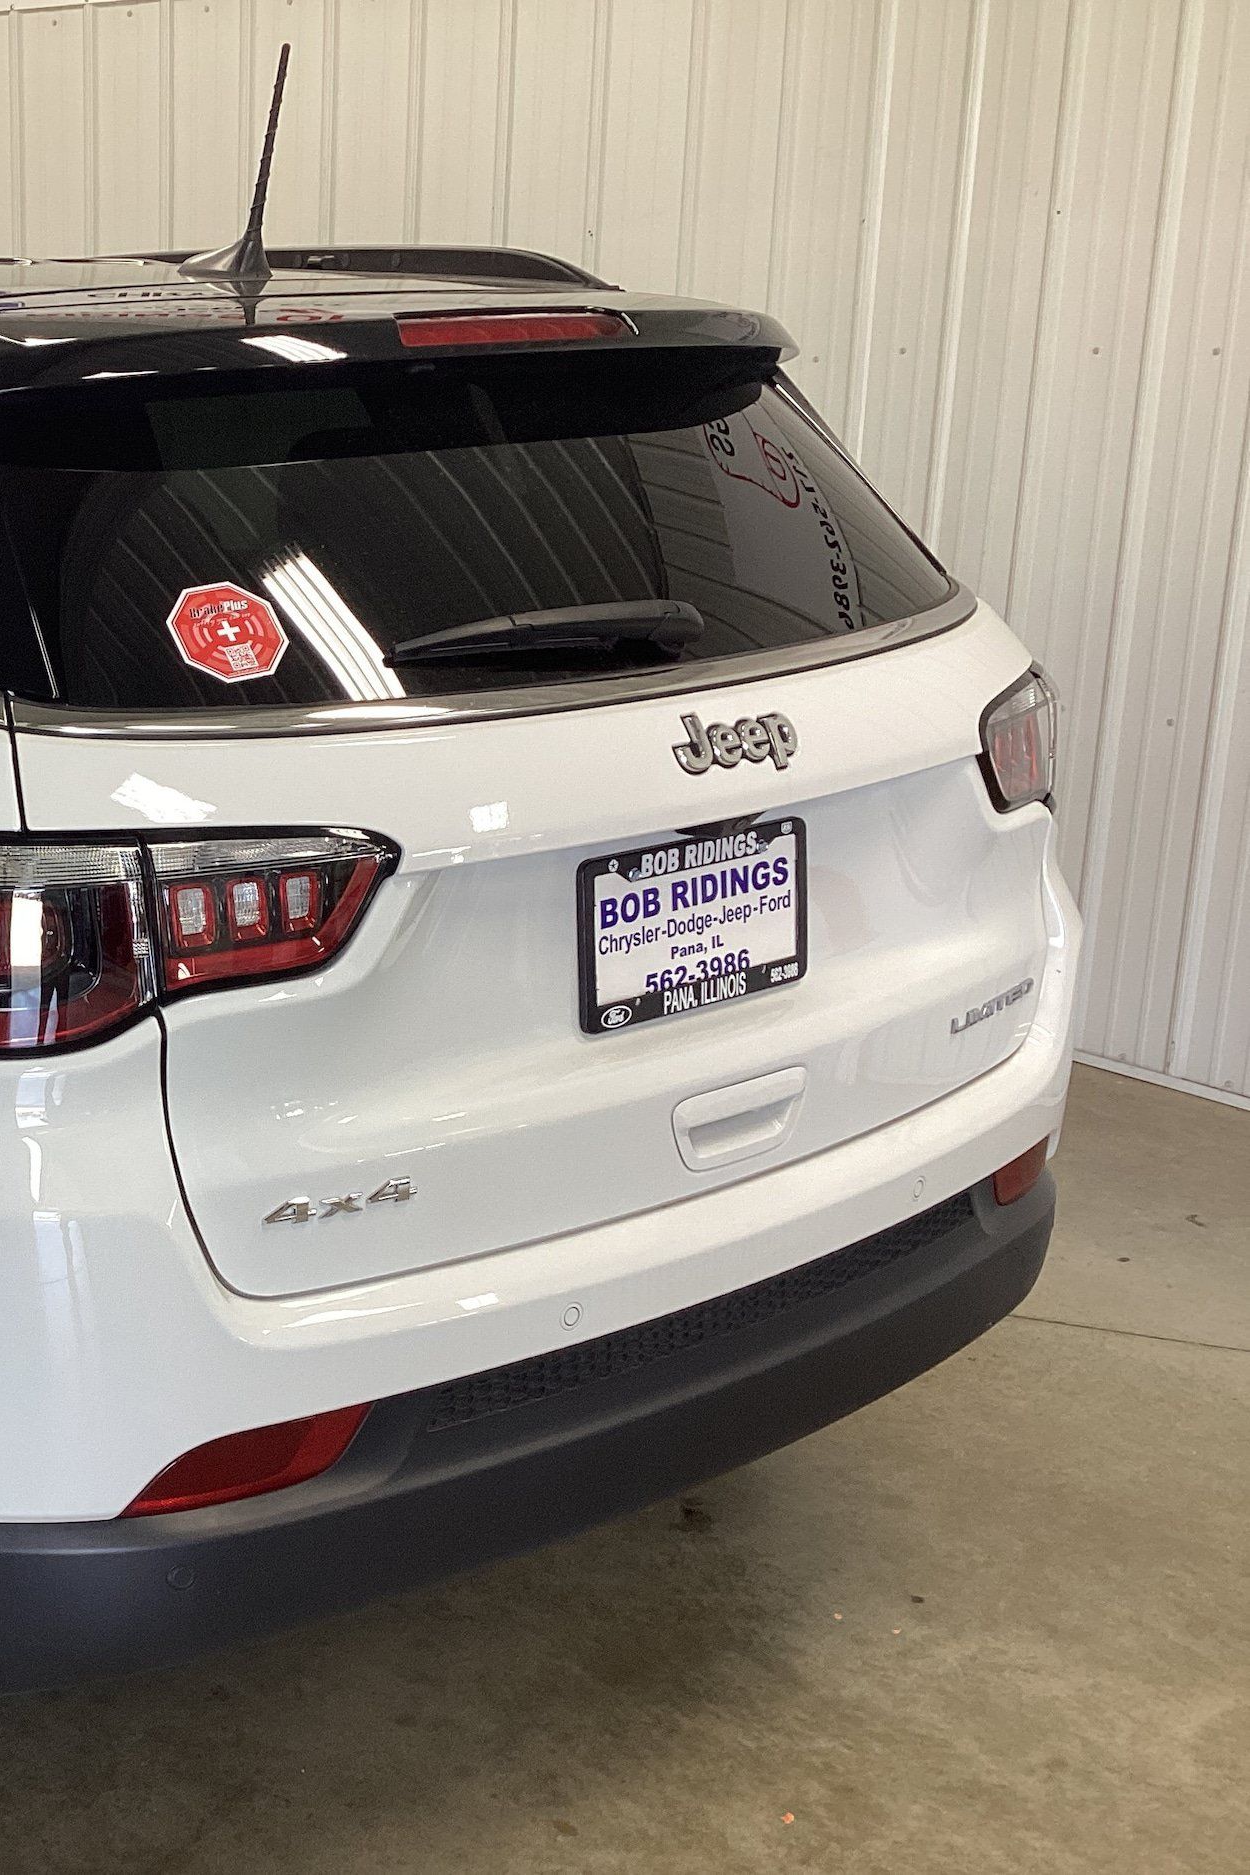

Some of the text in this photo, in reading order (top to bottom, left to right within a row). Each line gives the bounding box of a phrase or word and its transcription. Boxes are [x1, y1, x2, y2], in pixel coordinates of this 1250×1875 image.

[671, 711, 798, 776] Jeep
[640, 830, 758, 878] BOB RIDINGS
[600, 856, 789, 930] BOB RIDINGS
[599, 890, 791, 955] Chrysler-Dodge-Jeep-Ford
[646, 949, 751, 994] 562-3986
[670, 935, 725, 960] Pana, IL
[701, 972, 747, 1005] ILLINOIS
